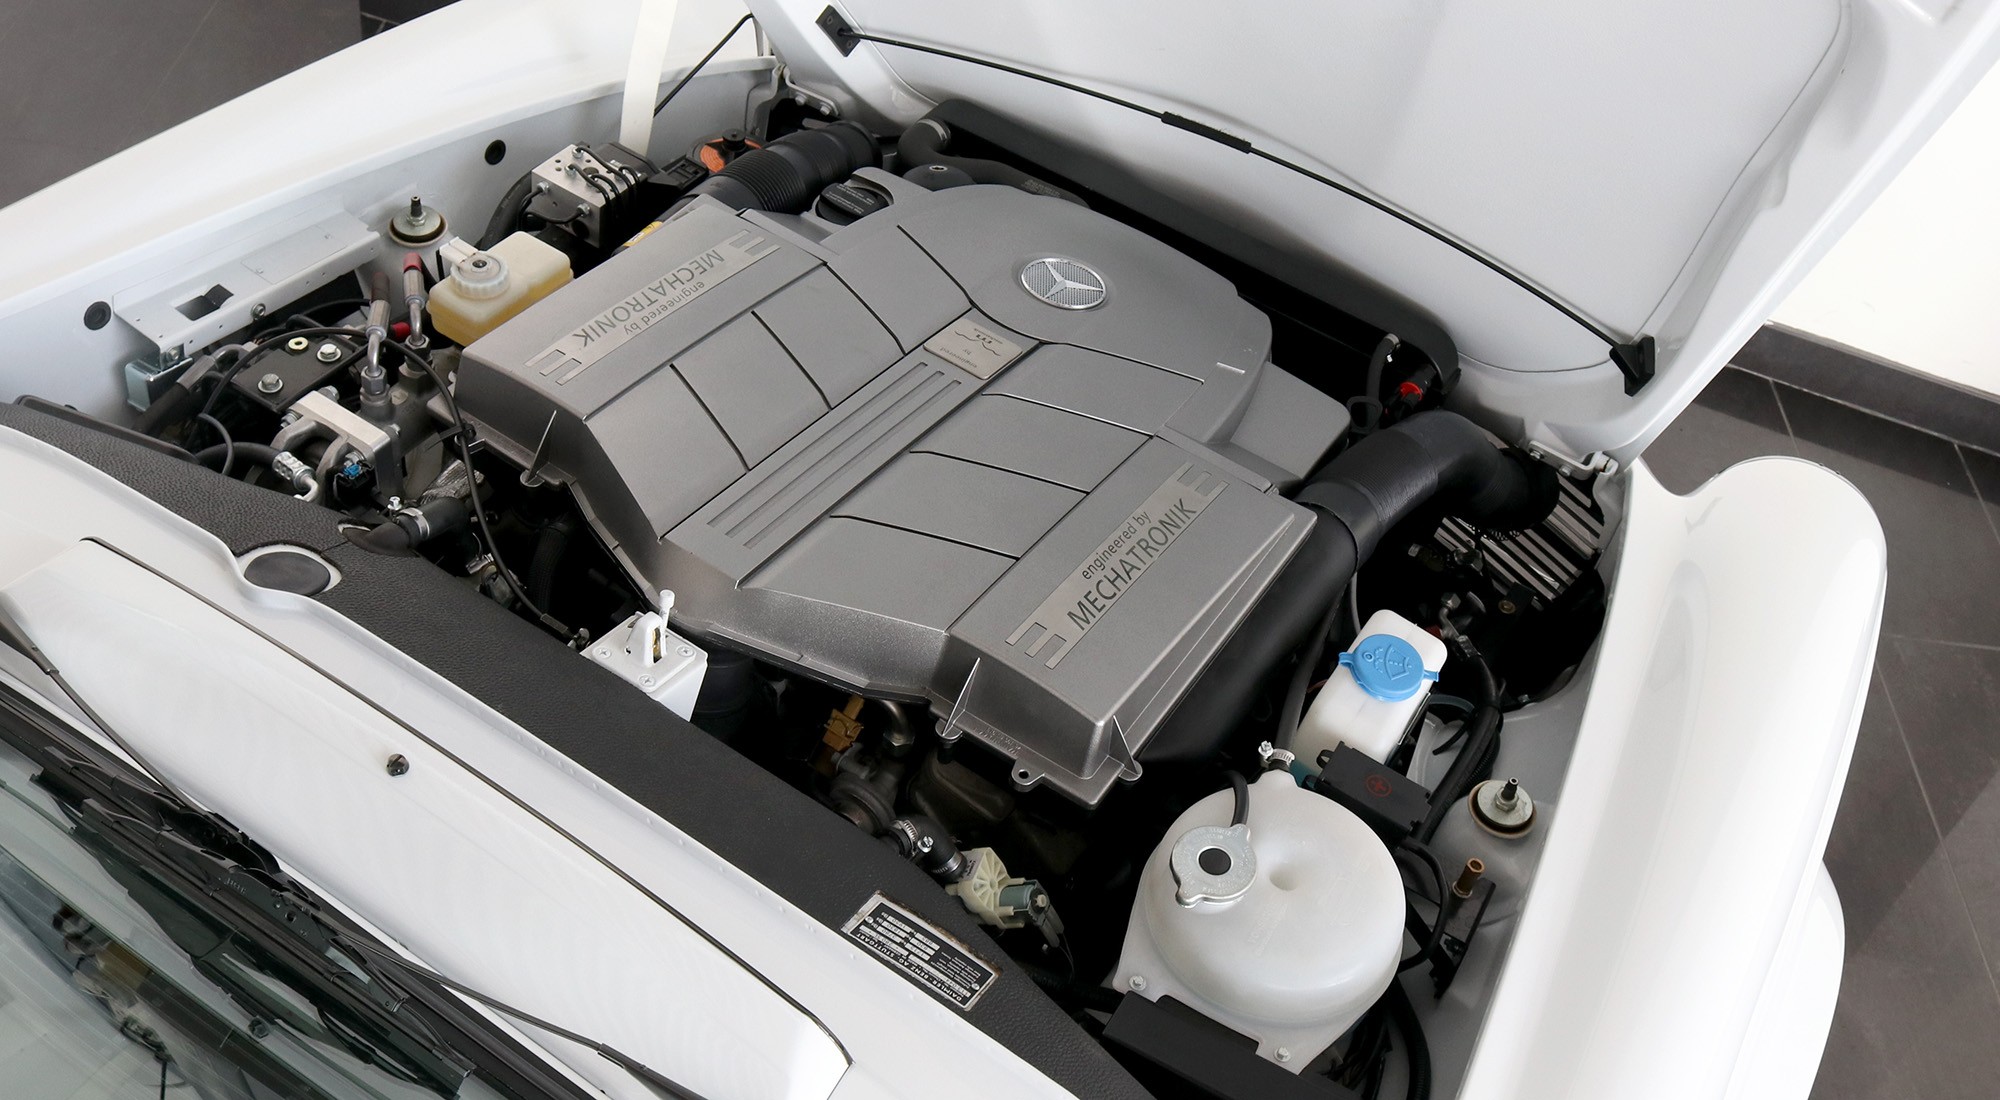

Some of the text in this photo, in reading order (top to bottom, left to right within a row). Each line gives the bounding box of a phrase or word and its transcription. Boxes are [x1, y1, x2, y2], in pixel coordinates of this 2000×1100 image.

[572, 249, 725, 347] MECHATRONIK
[623, 281, 705, 335] engineered by
[1066, 498, 1197, 631] MECHATRONIK
[1082, 511, 1152, 580] engineered by
[856, 934, 895, 957] STUTTGART
